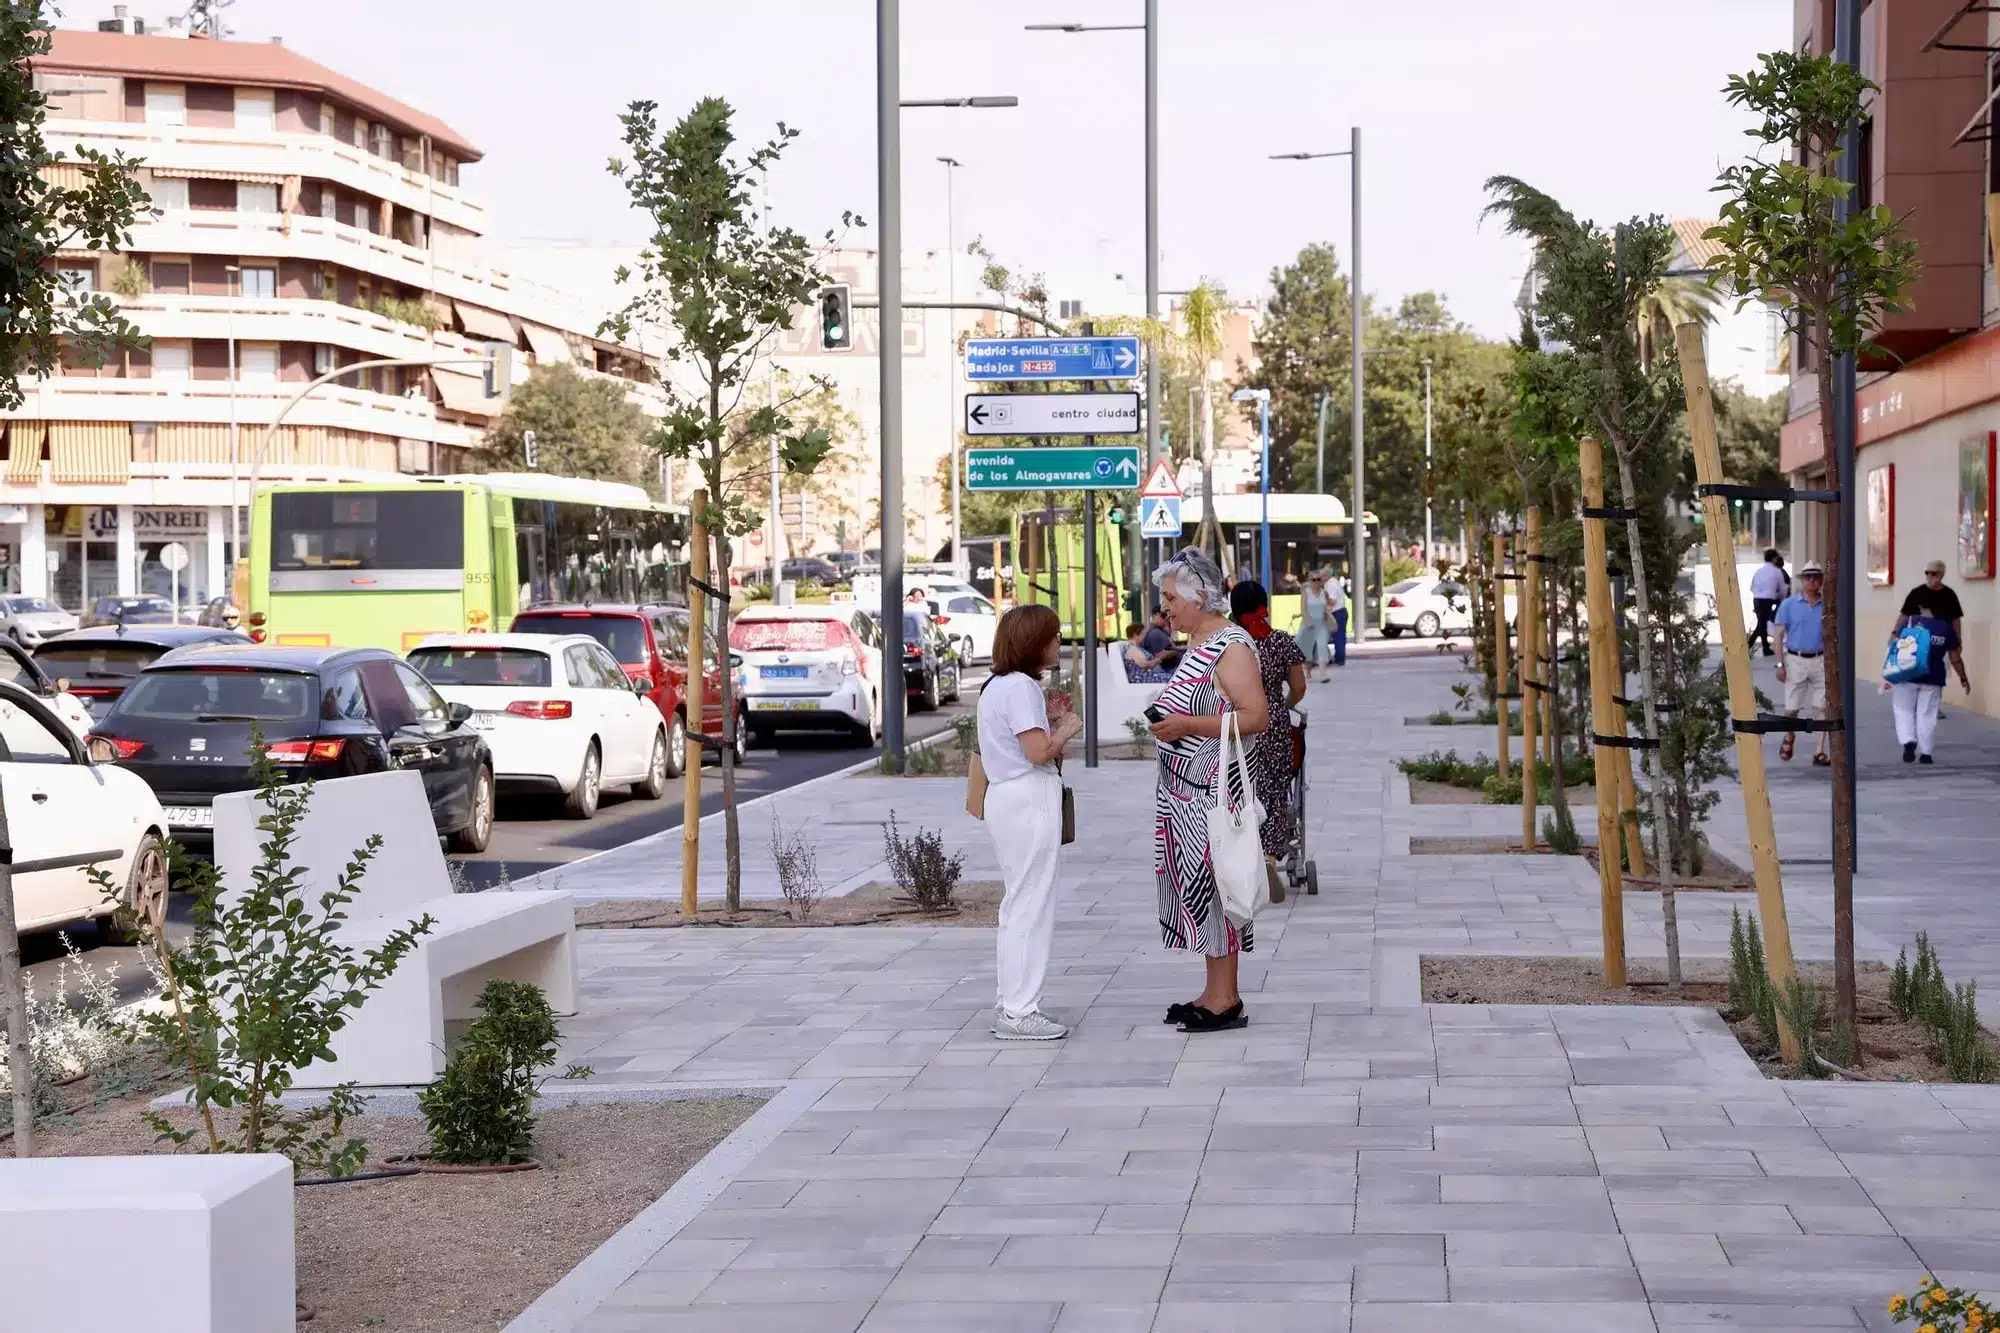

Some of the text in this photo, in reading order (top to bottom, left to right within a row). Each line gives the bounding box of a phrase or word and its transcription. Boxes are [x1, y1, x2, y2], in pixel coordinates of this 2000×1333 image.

[967, 361, 1055, 374] Badajoz N-432
[1051, 408, 1136, 418] centro ciudad
[969, 455, 1015, 466] avenida
[969, 470, 1092, 482] de los Almogavares
[465, 572, 490, 584] 955
